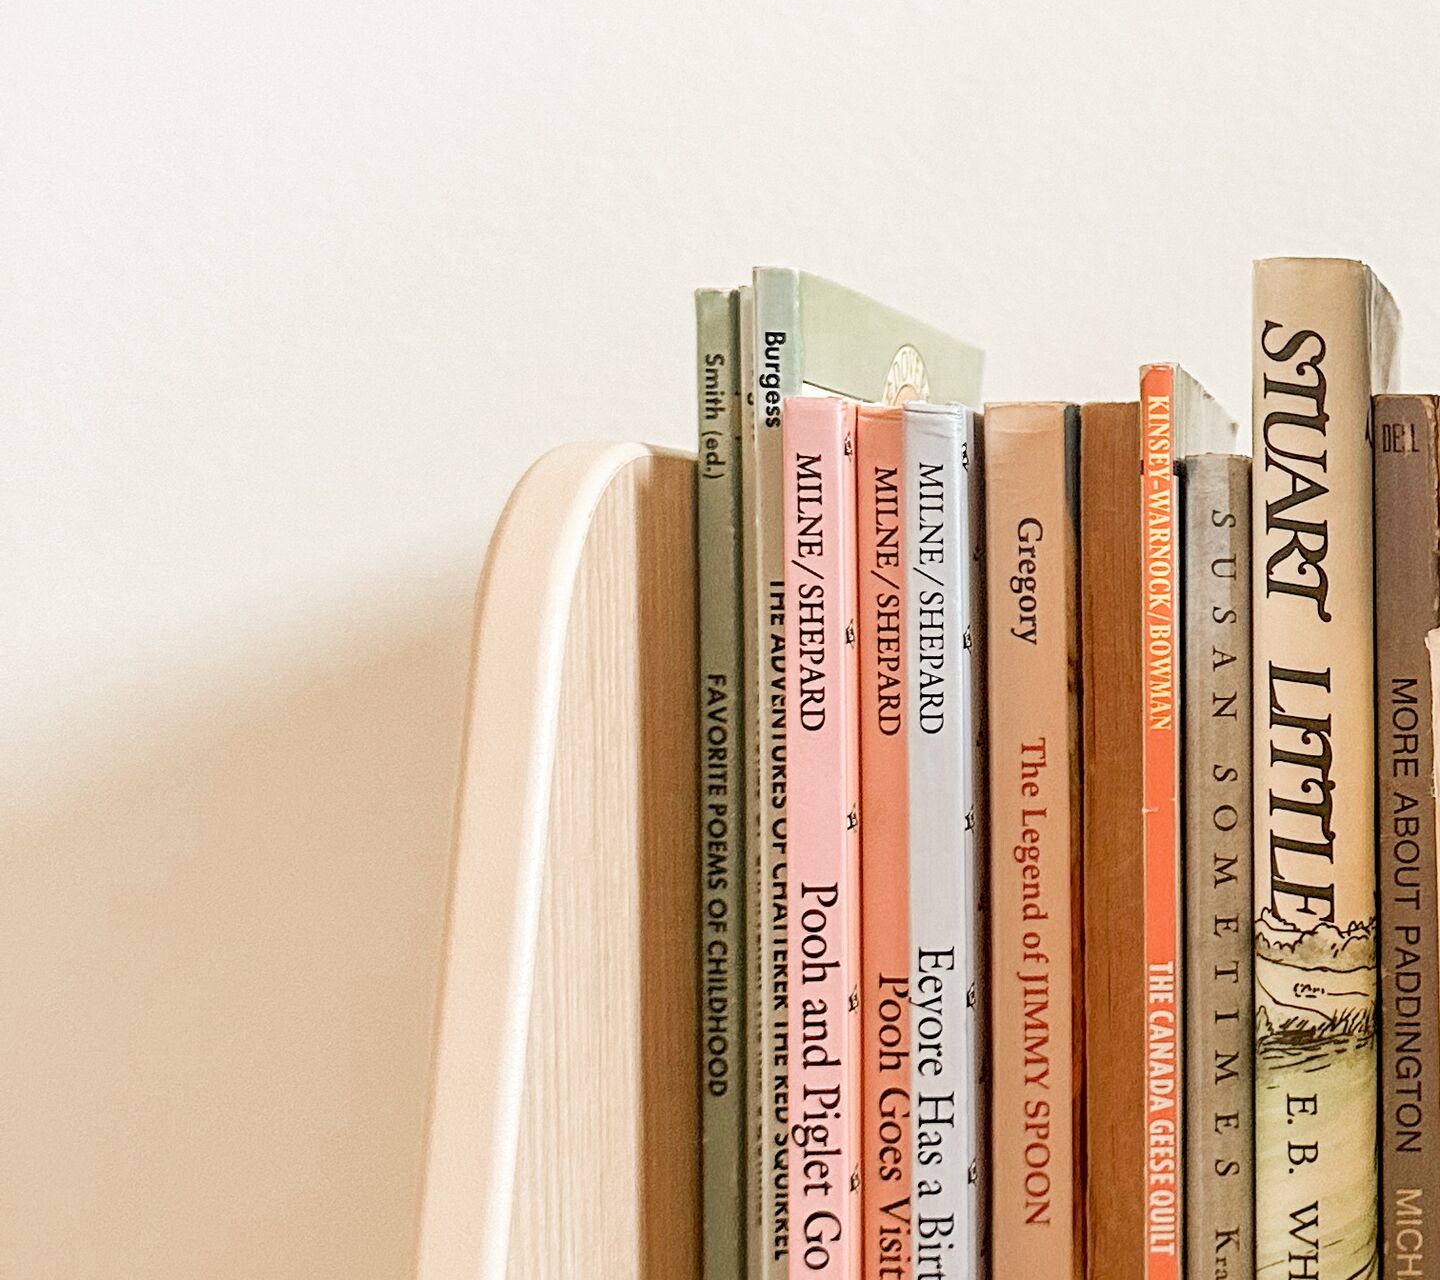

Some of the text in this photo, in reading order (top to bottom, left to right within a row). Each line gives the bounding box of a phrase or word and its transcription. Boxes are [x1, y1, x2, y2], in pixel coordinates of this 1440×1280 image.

[702, 353, 727, 481] Smith (ed.)
[759, 331, 786, 428] Burgess
[791, 452, 826, 732] MILNE/SHEPARD
[871, 466, 902, 736] MILNE/SHEPARD
[913, 462, 945, 735] MILNE/SHEPARD
[1009, 517, 1044, 646] Gregory
[1146, 395, 1172, 731] KINSEY-WARNOCK/BOWMAN
[1211, 510, 1238, 720] SUSAN
[1261, 319, 1337, 923] STUART LITTLE
[706, 672, 729, 1097] FAVORITE POEMS OF CHILDHOOD
[800, 882, 841, 985] Pooh
[1391, 678, 1423, 1153] MORE ABOUT PADDINGTON
[801, 998, 842, 1070] and
[878, 973, 909, 1073] Pooh
[910, 946, 955, 1077] Eeyore
[1013, 736, 1051, 1225] The Legend of JIMMY SPOON
[1212, 764, 1241, 1177] SOMETIMES
[791, 1084, 842, 1197] Piglet
[878, 1087, 909, 1181] Goes
[917, 1091, 955, 1165] Has
[1148, 960, 1176, 1256] THE CANADA GEESE QUILT
[1286, 1093, 1318, 1125] E.
[1287, 1140, 1319, 1175] B.
[803, 1210, 842, 1271] Go
[917, 1180, 943, 1199] a
